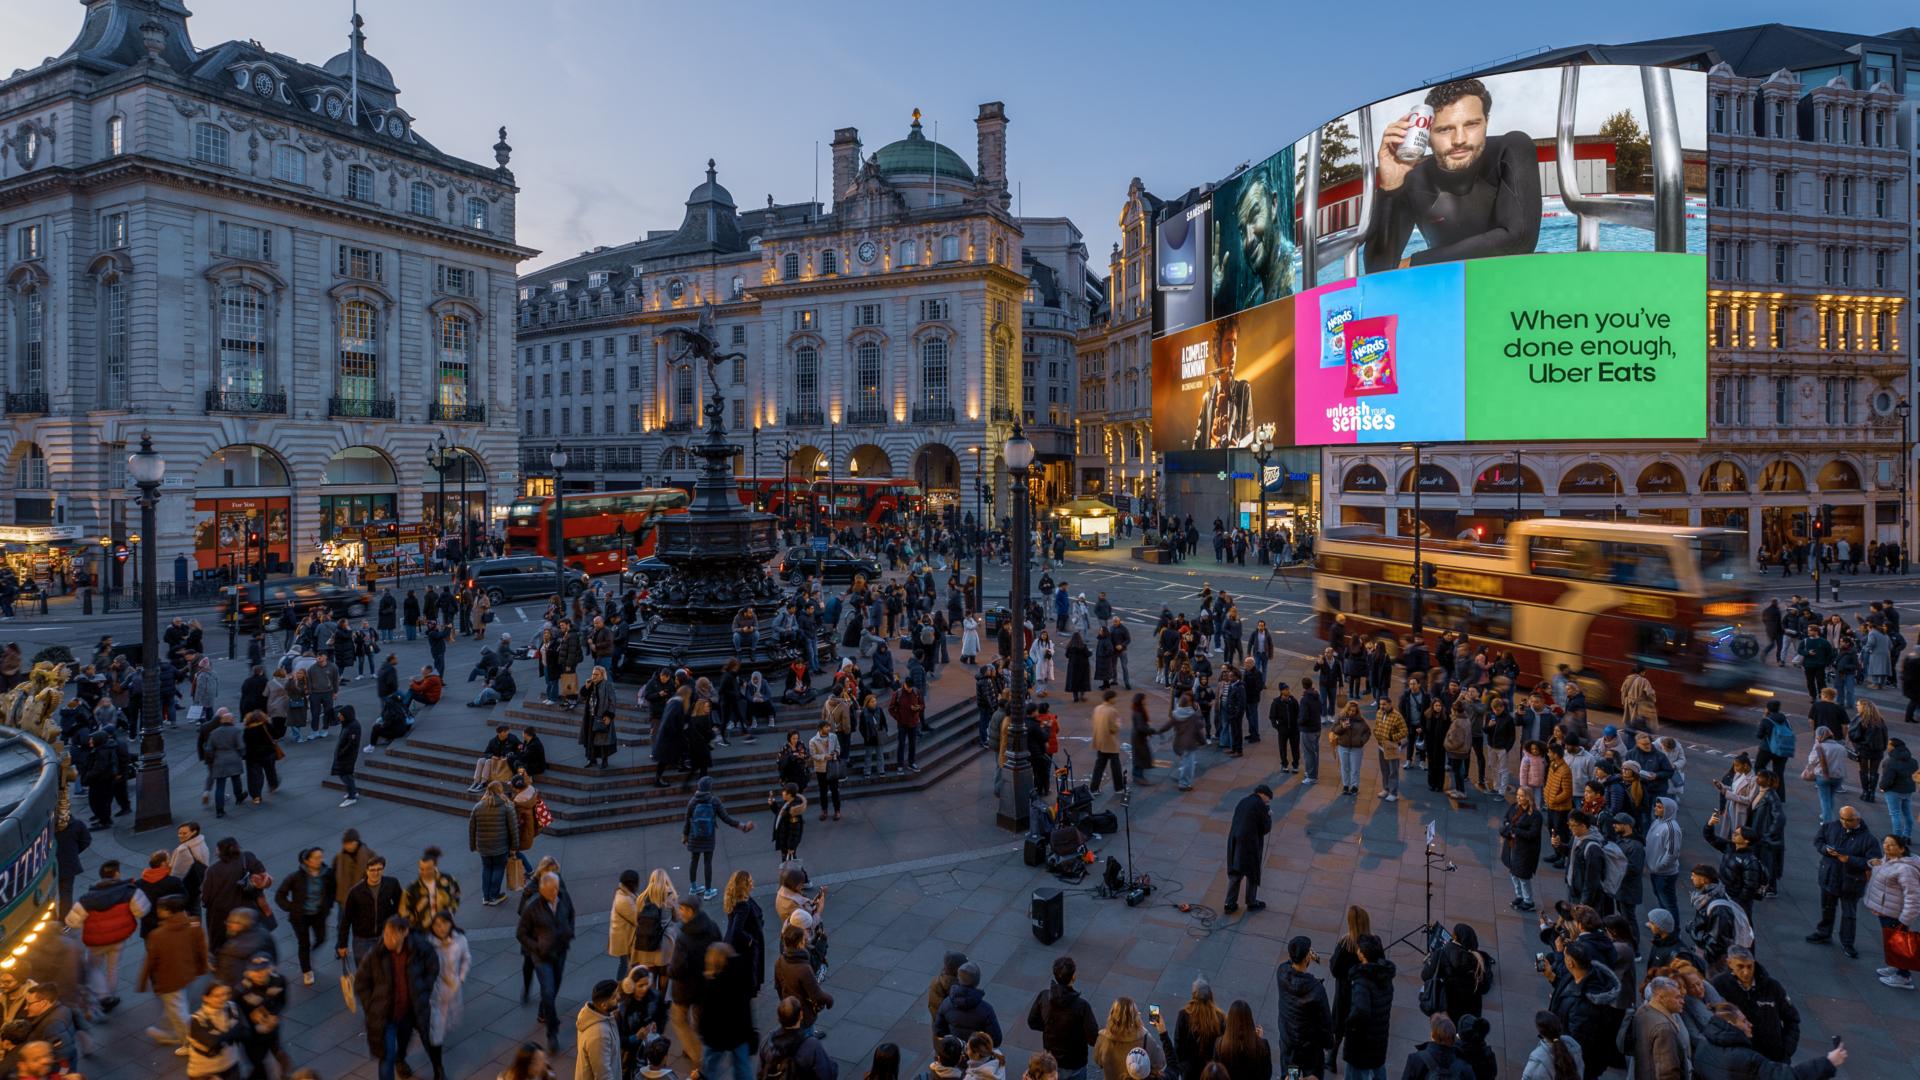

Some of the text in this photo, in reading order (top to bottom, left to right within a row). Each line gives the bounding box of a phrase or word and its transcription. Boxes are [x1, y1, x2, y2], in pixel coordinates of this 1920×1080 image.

[1186, 199, 1211, 222] SAMSUNG
[1510, 307, 1671, 334] When you've
[1185, 341, 1208, 362] COMPLETE
[1503, 335, 1677, 361] done enough,
[1182, 359, 1206, 379] UNKNOWN
[1529, 361, 1656, 384] Uber Eats
[1326, 401, 1387, 419] unleash YOUR
[1332, 413, 1396, 433] senses
